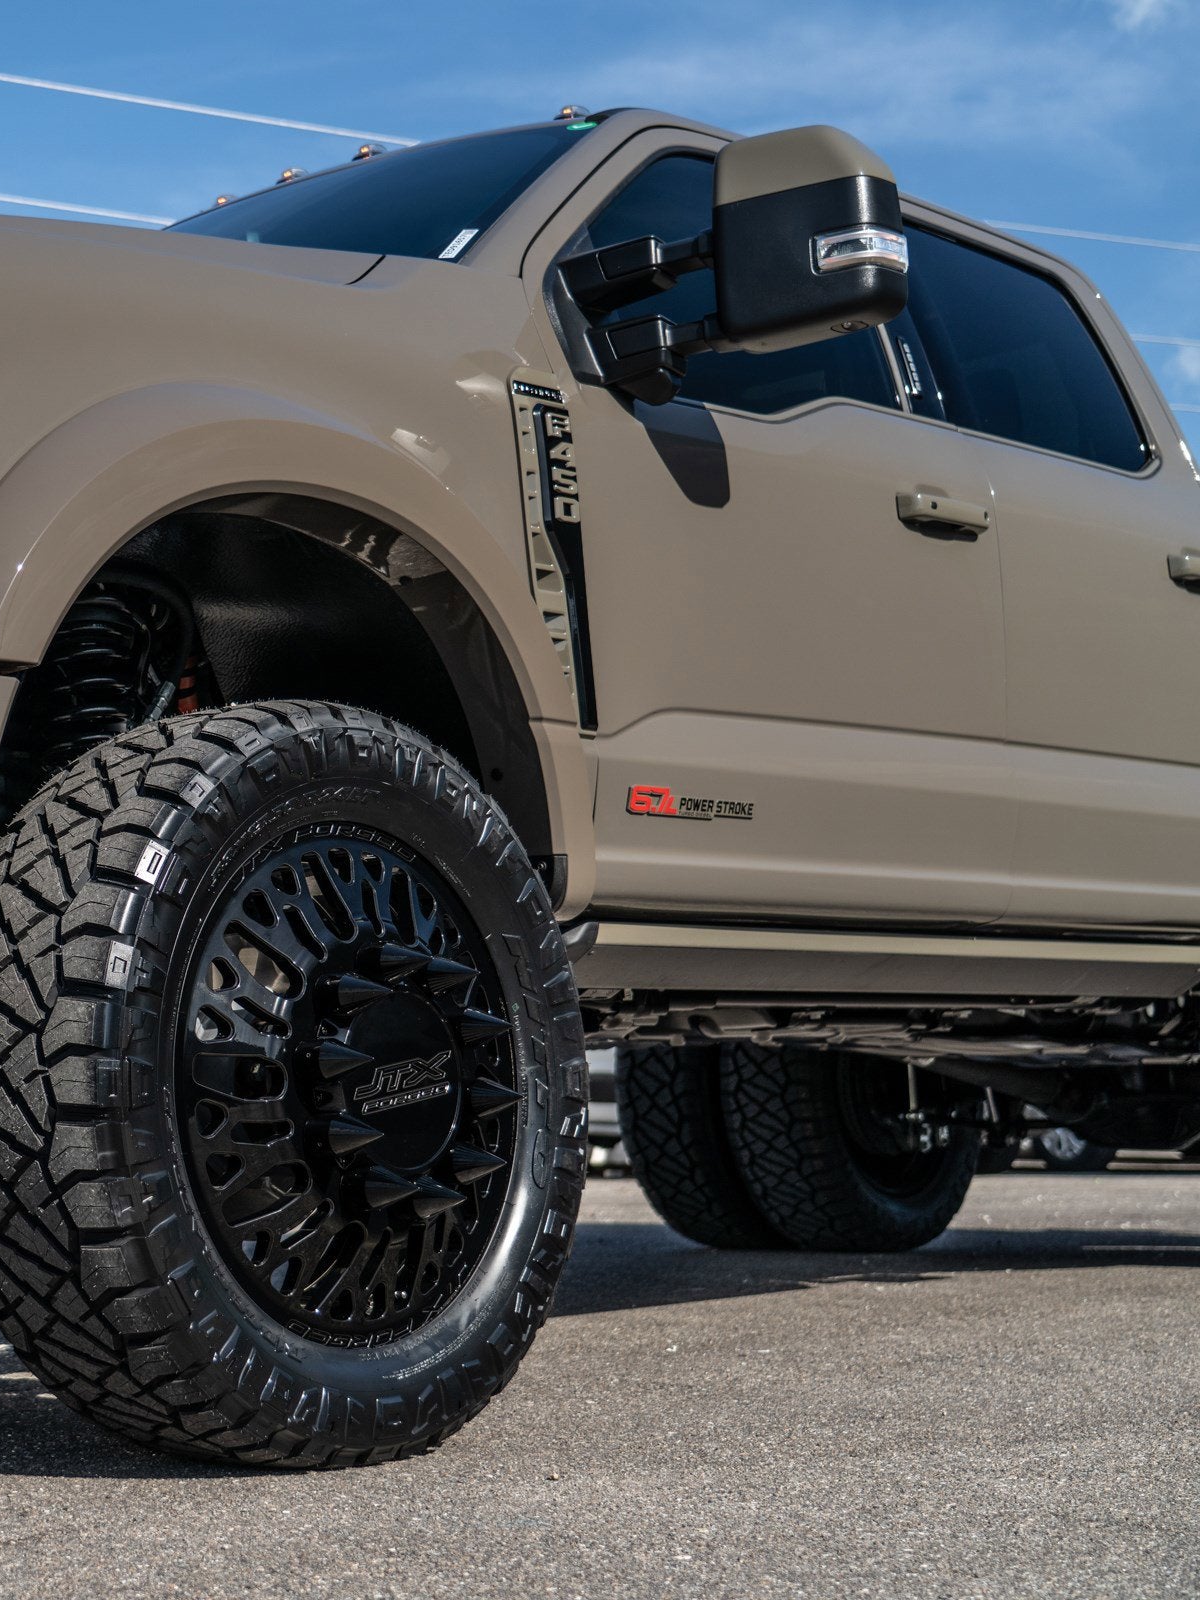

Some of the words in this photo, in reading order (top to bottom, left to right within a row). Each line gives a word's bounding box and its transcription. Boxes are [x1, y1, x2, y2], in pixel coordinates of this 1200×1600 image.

[627, 785, 677, 815] 6.7L
[679, 797, 714, 813] POWER
[715, 800, 754, 816] STROKE
[353, 1050, 451, 1100] JTX
